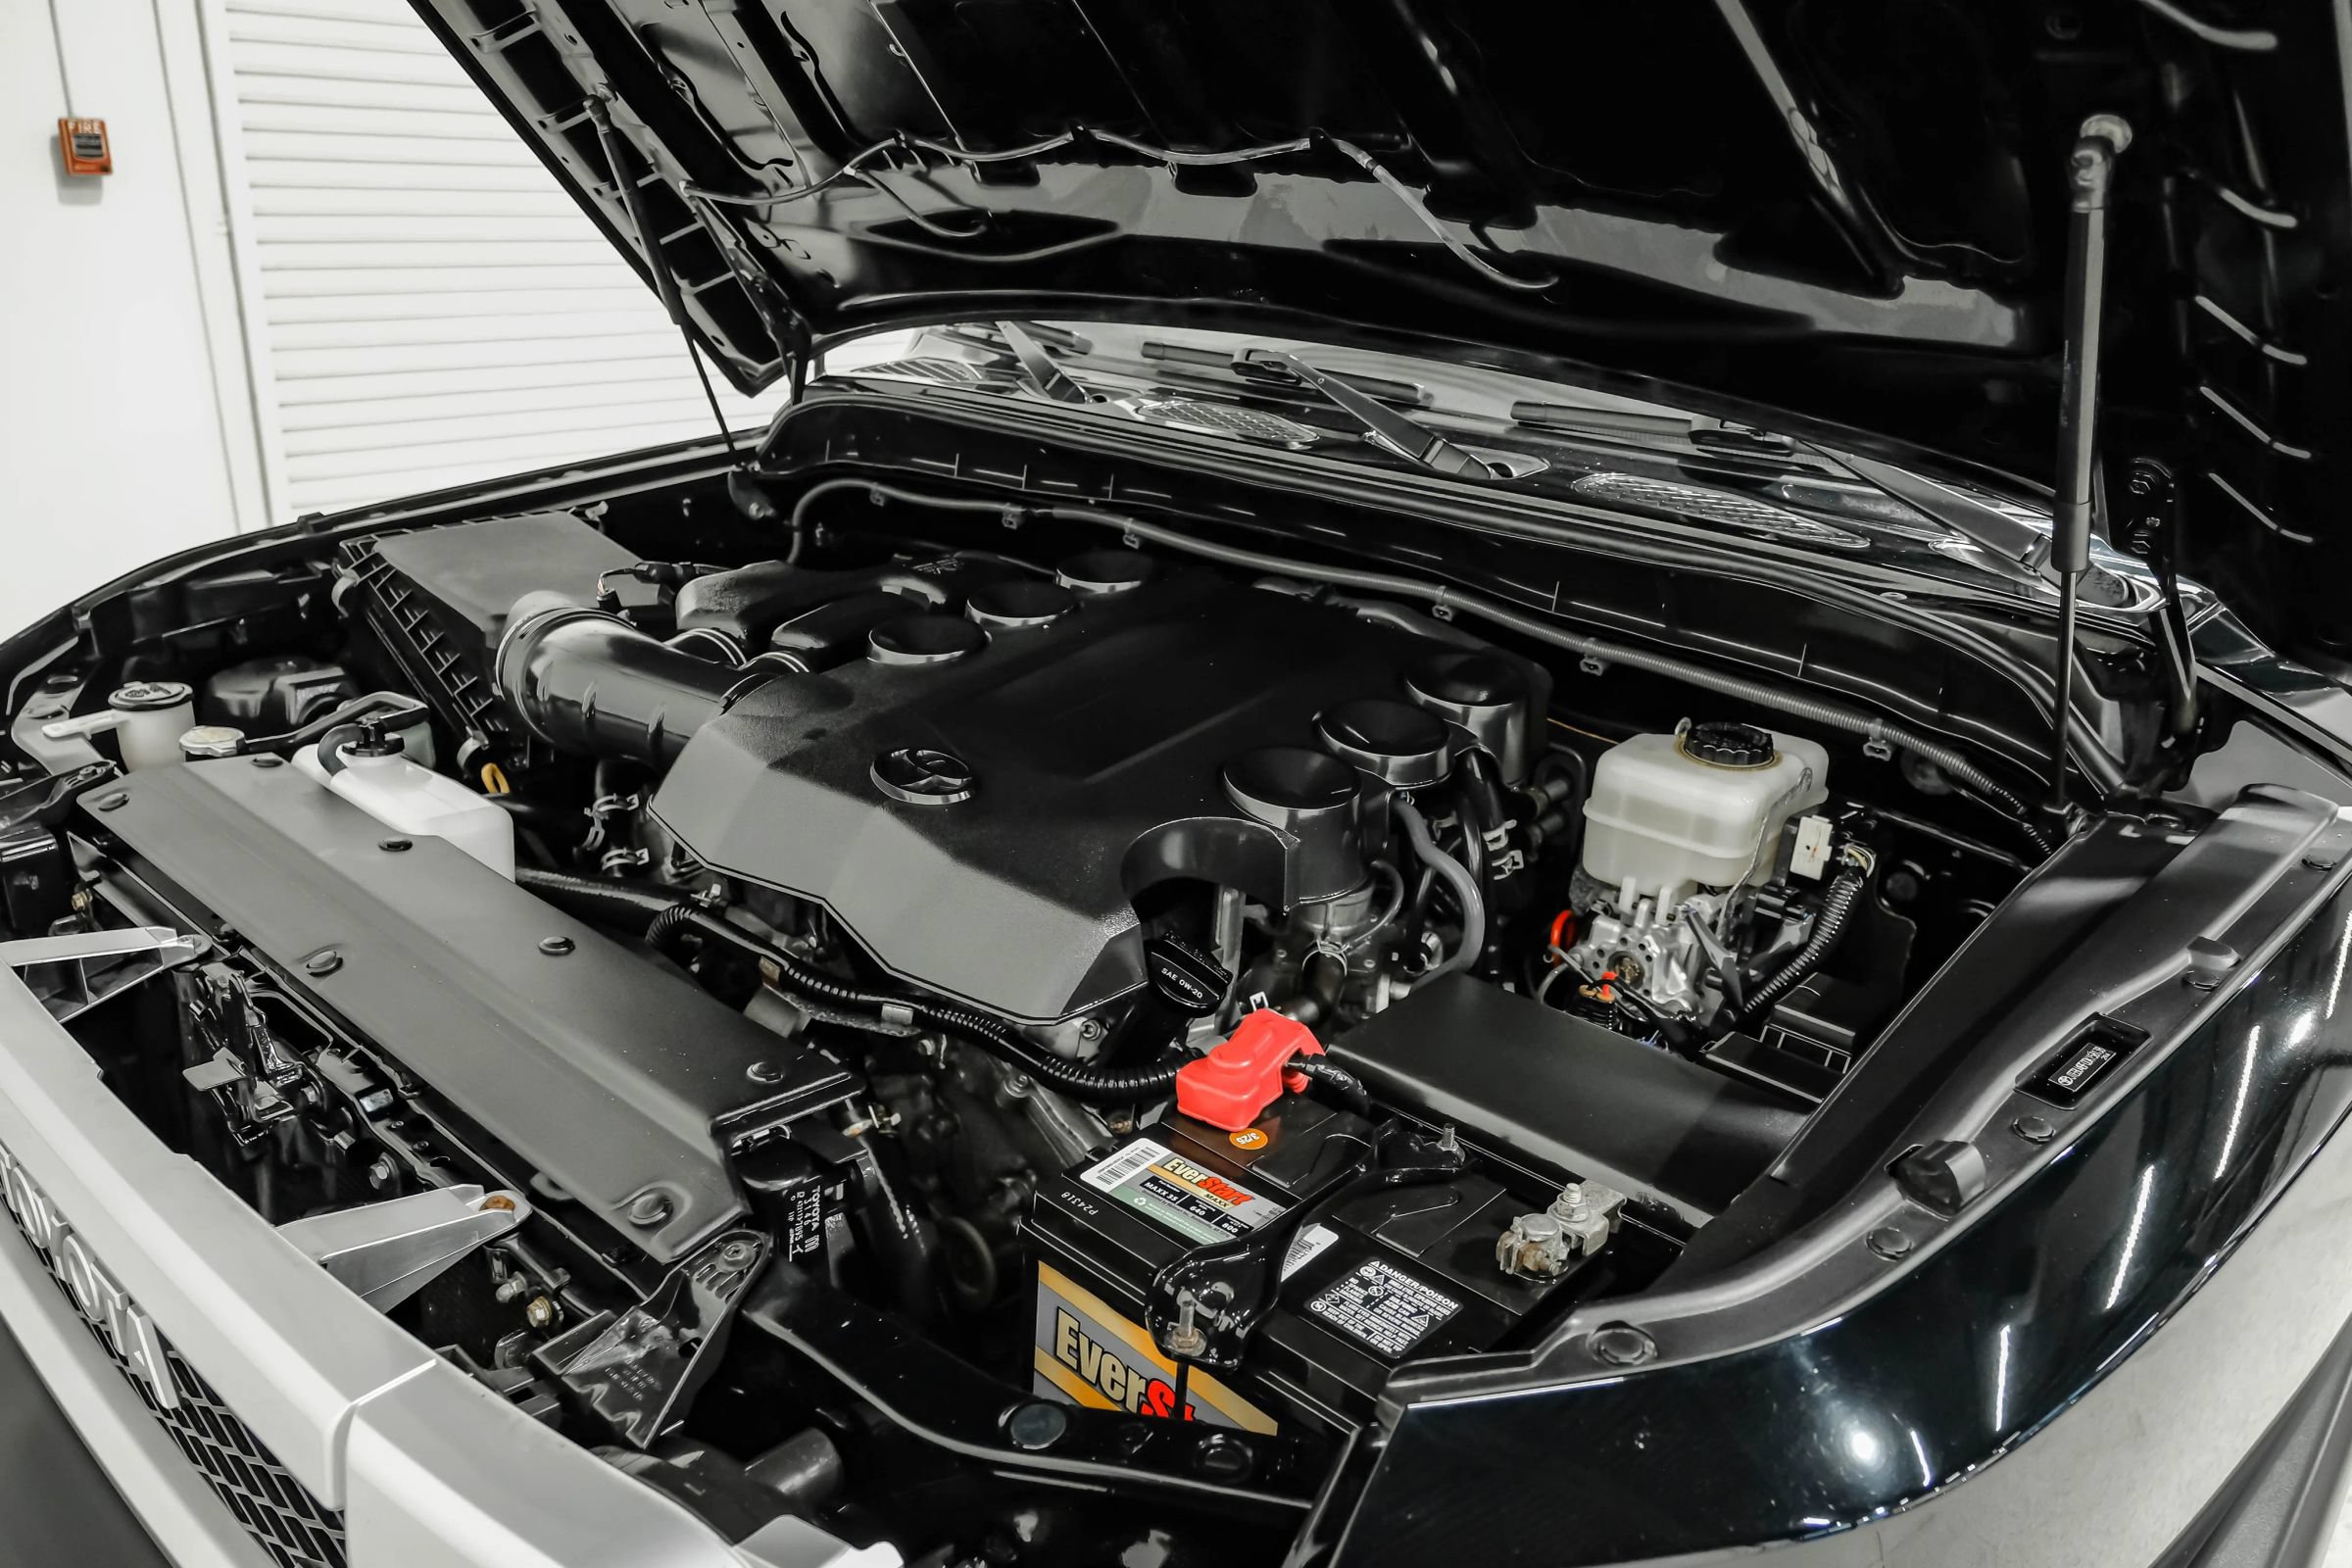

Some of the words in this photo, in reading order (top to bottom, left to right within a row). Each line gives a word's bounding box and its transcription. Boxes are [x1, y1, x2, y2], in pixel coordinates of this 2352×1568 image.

[68, 120, 103, 134] FIRE
[1161, 967, 1178, 981] SAE
[1179, 979, 1203, 999] 0W-20
[1235, 1132, 1260, 1145] 3/25
[1144, 1182, 1169, 1197] MAXX
[1162, 1157, 1253, 1206] EverStart
[811, 1185, 821, 1232] TOYOTA
[1189, 1205, 1206, 1216] 640
[1204, 1194, 1230, 1207] MAXX
[1221, 1222, 1239, 1234] 800
[0, 1143, 182, 1411] TOYOTA
[1377, 1263, 1458, 1309] DANGER/POISON
[1055, 1306, 1195, 1421] EverS
